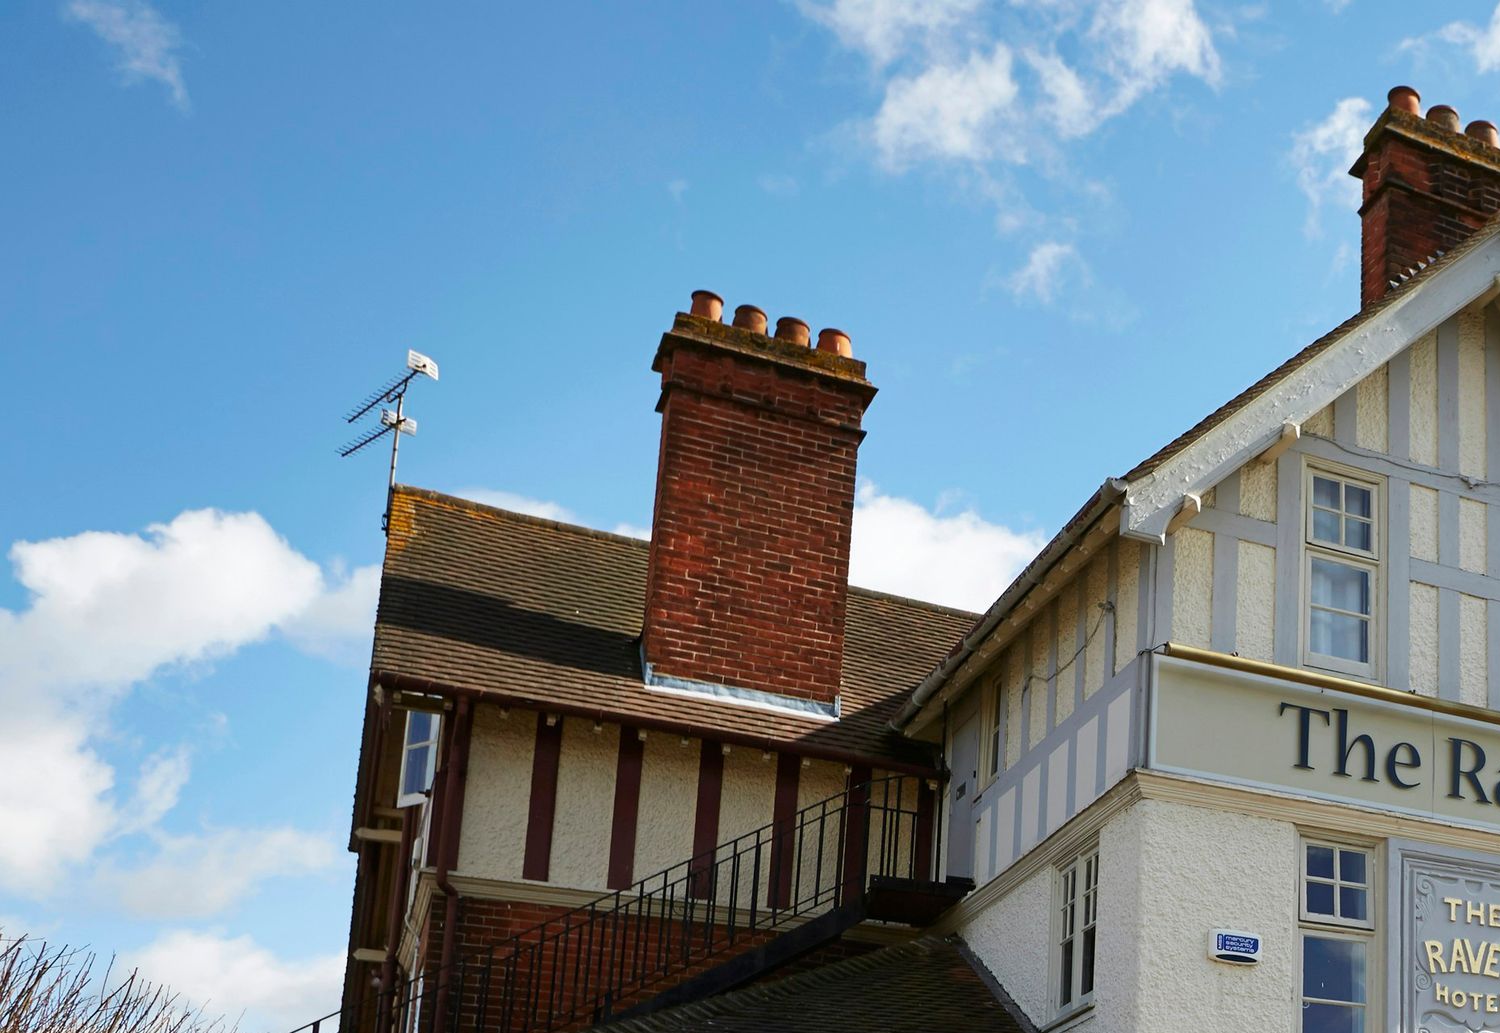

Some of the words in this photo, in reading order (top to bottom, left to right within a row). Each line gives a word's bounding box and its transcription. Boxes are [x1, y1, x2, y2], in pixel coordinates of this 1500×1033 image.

[1280, 702, 1421, 789] The
[1225, 936, 1255, 944] mercury
[1225, 940, 1254, 949] security
[1225, 945, 1255, 953] systems
